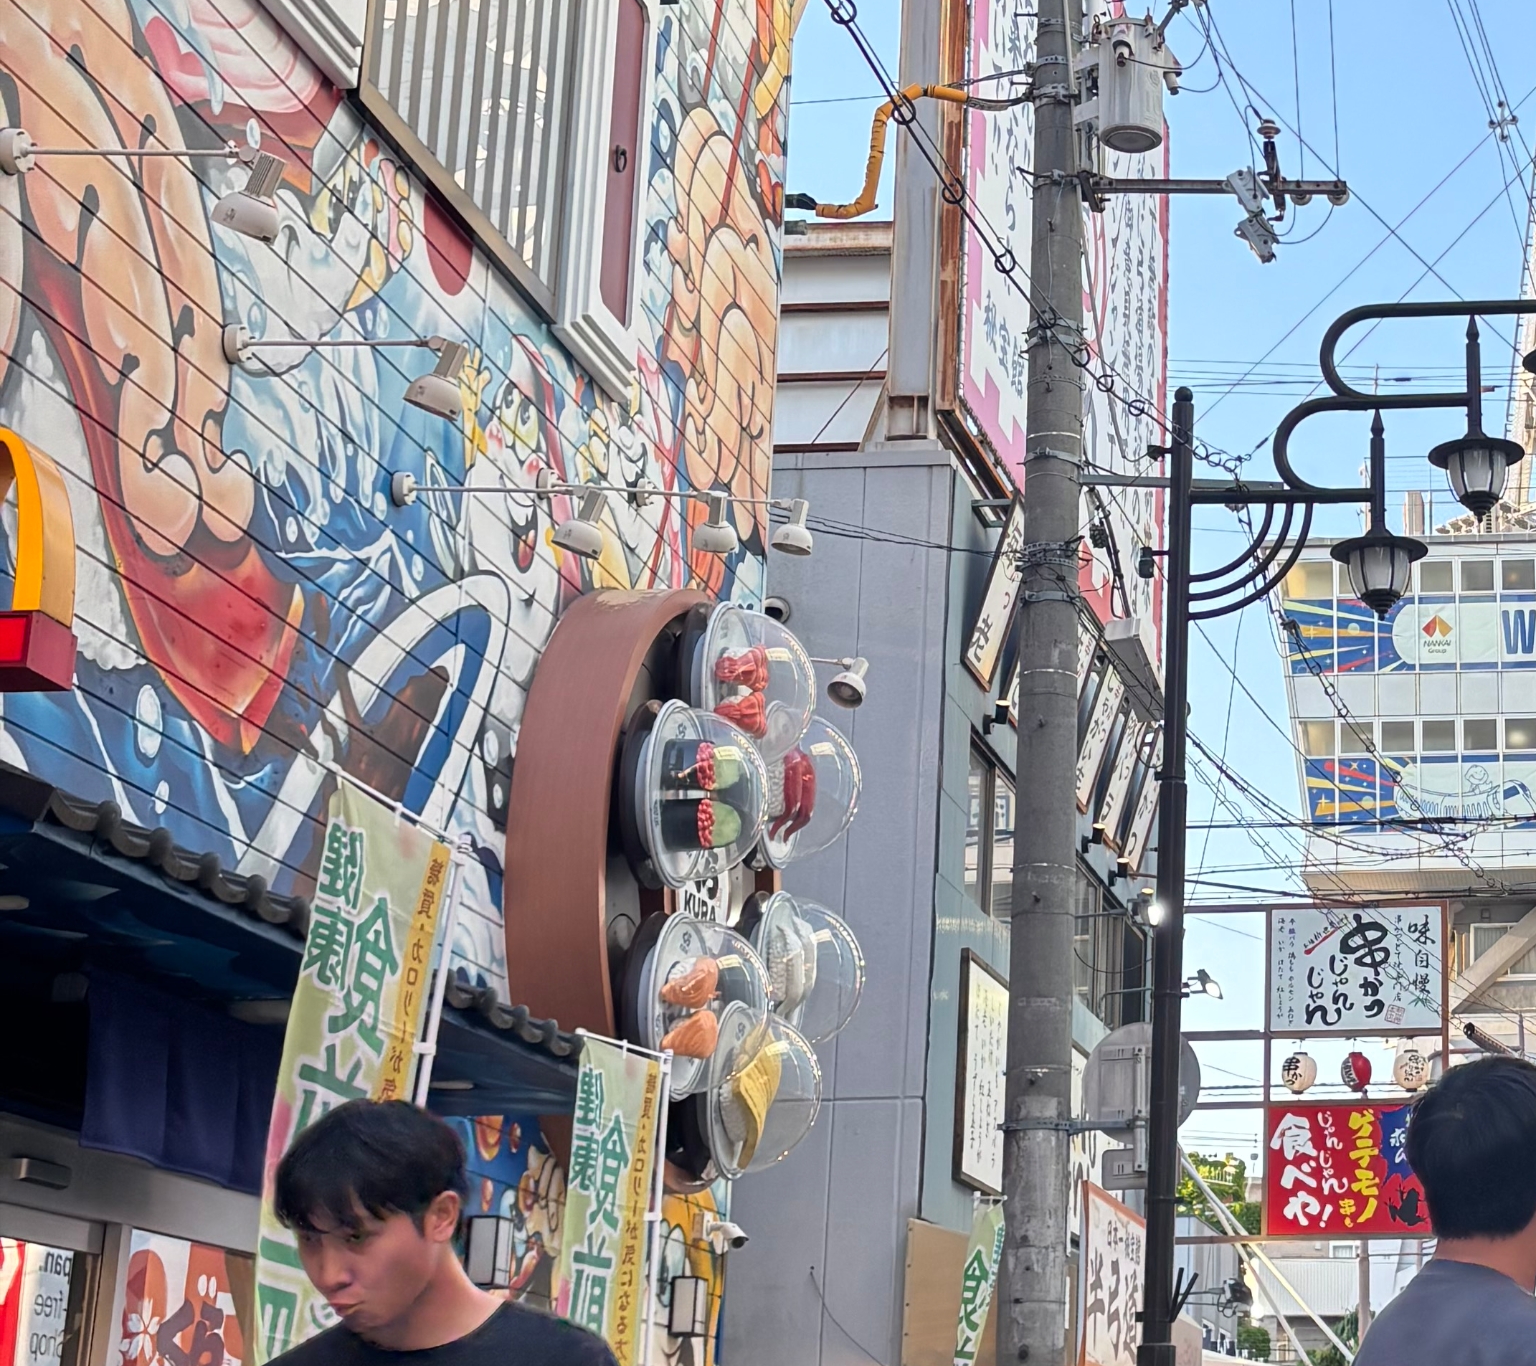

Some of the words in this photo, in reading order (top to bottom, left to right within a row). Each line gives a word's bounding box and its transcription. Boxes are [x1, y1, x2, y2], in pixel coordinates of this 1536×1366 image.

[1340, 913, 1391, 1018] 串かつ
[1408, 914, 1437, 995] 味自慢
[1270, 1112, 1333, 1228] 食べや!
[1348, 1109, 1379, 1223] ゲテモノ
